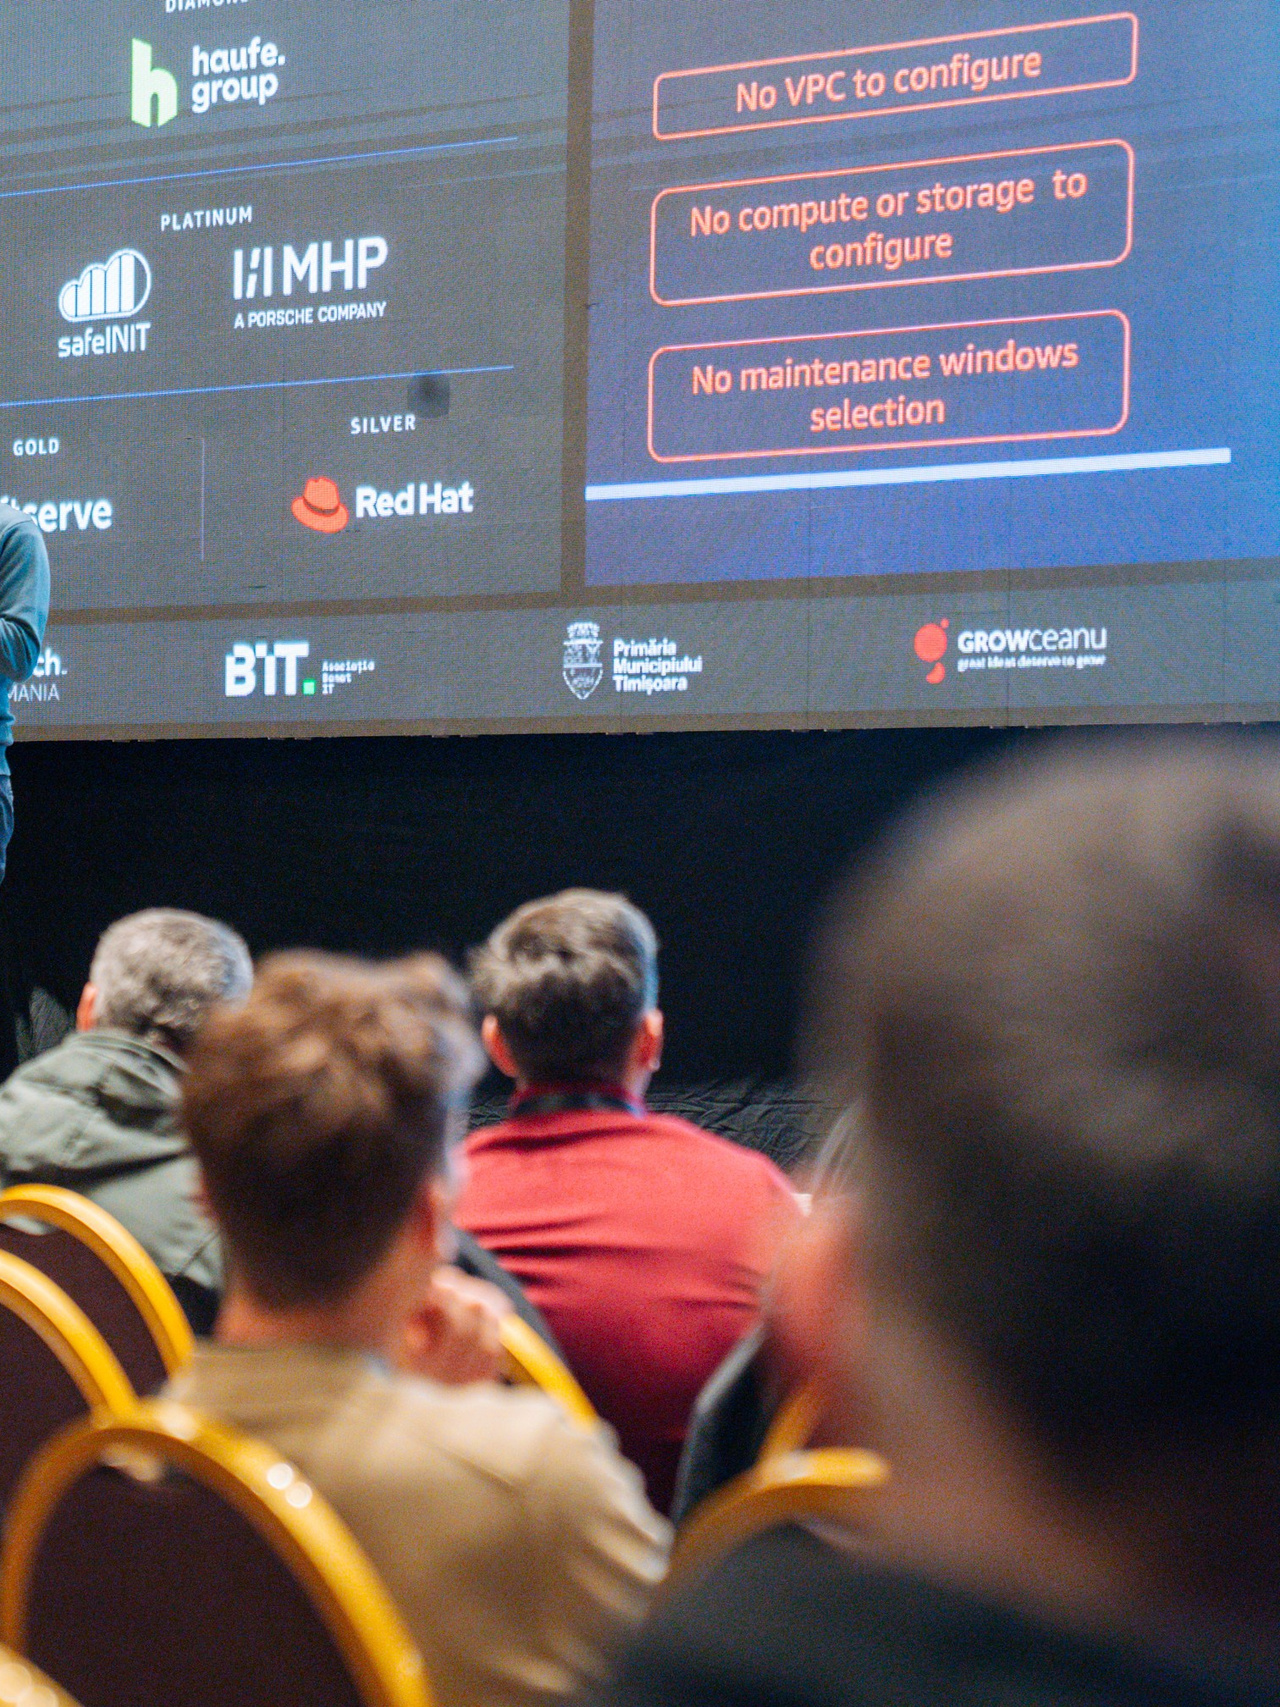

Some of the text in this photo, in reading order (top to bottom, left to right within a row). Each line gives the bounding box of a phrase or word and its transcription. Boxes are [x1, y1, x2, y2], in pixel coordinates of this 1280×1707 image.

[165, 0, 248, 13] DIAM
[192, 36, 286, 76] haufe.
[191, 73, 279, 114] group
[736, 51, 1042, 113] No VPC to configure
[690, 168, 1087, 236] No compute or storage to
[160, 206, 253, 232] PLATINUM
[809, 230, 953, 270] configure
[282, 236, 388, 296] MHP
[233, 301, 387, 329] A PORSCHE COMPANY
[57, 322, 151, 358] safeINIT
[692, 338, 1079, 394] No maintenance windows
[350, 414, 416, 434] SILVER
[810, 397, 945, 432] selection
[13, 438, 60, 456] GOLD
[355, 480, 474, 518] Red Hat
[613, 637, 677, 657] Primăria
[957, 626, 1108, 654] GROWceanu
[613, 655, 703, 676] Municipiului
[8, 683, 60, 702] MANIA
[322, 683, 335, 695] IT
